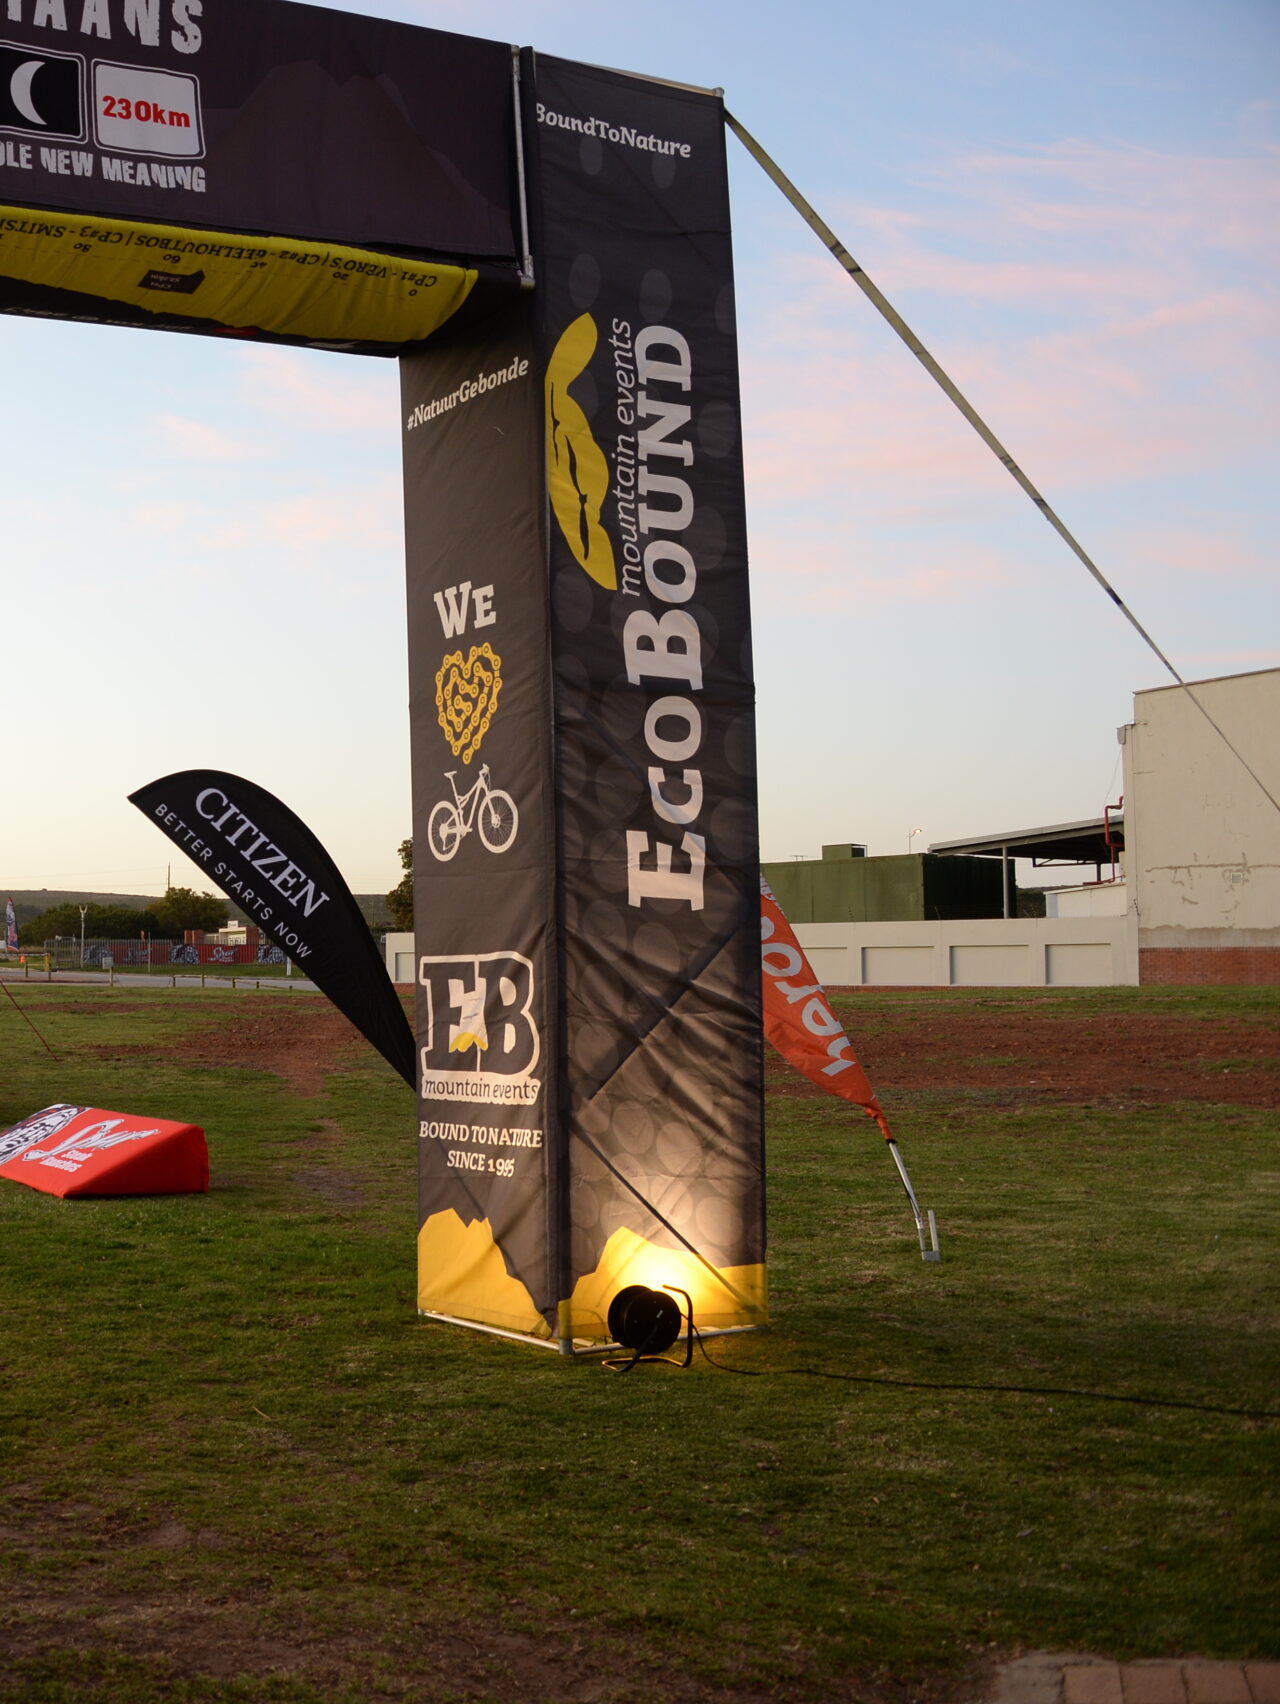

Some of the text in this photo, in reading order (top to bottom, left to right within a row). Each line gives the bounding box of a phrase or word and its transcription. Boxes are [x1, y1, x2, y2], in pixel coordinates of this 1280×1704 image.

[102, 95, 191, 128] 230km
[536, 103, 692, 158] BoundToNature
[40, 147, 94, 177] NEW
[101, 156, 206, 193] MEANING
[78, 226, 124, 244] CP#3
[135, 234, 267, 262] GEELHOUTBOS
[331, 258, 388, 279] VERO'S
[402, 271, 438, 288] CP#1
[407, 356, 529, 432] #NatuurGebonde
[608, 317, 642, 598] mountain events
[195, 787, 330, 918] CITIZEN
[155, 803, 312, 959] BETTER STARTS NOW
[761, 916, 856, 1077] hero
[424, 1078, 538, 1099] mountain events
[419, 1121, 470, 1141] BOUND
[447, 1150, 515, 1178] SINCE 1995
